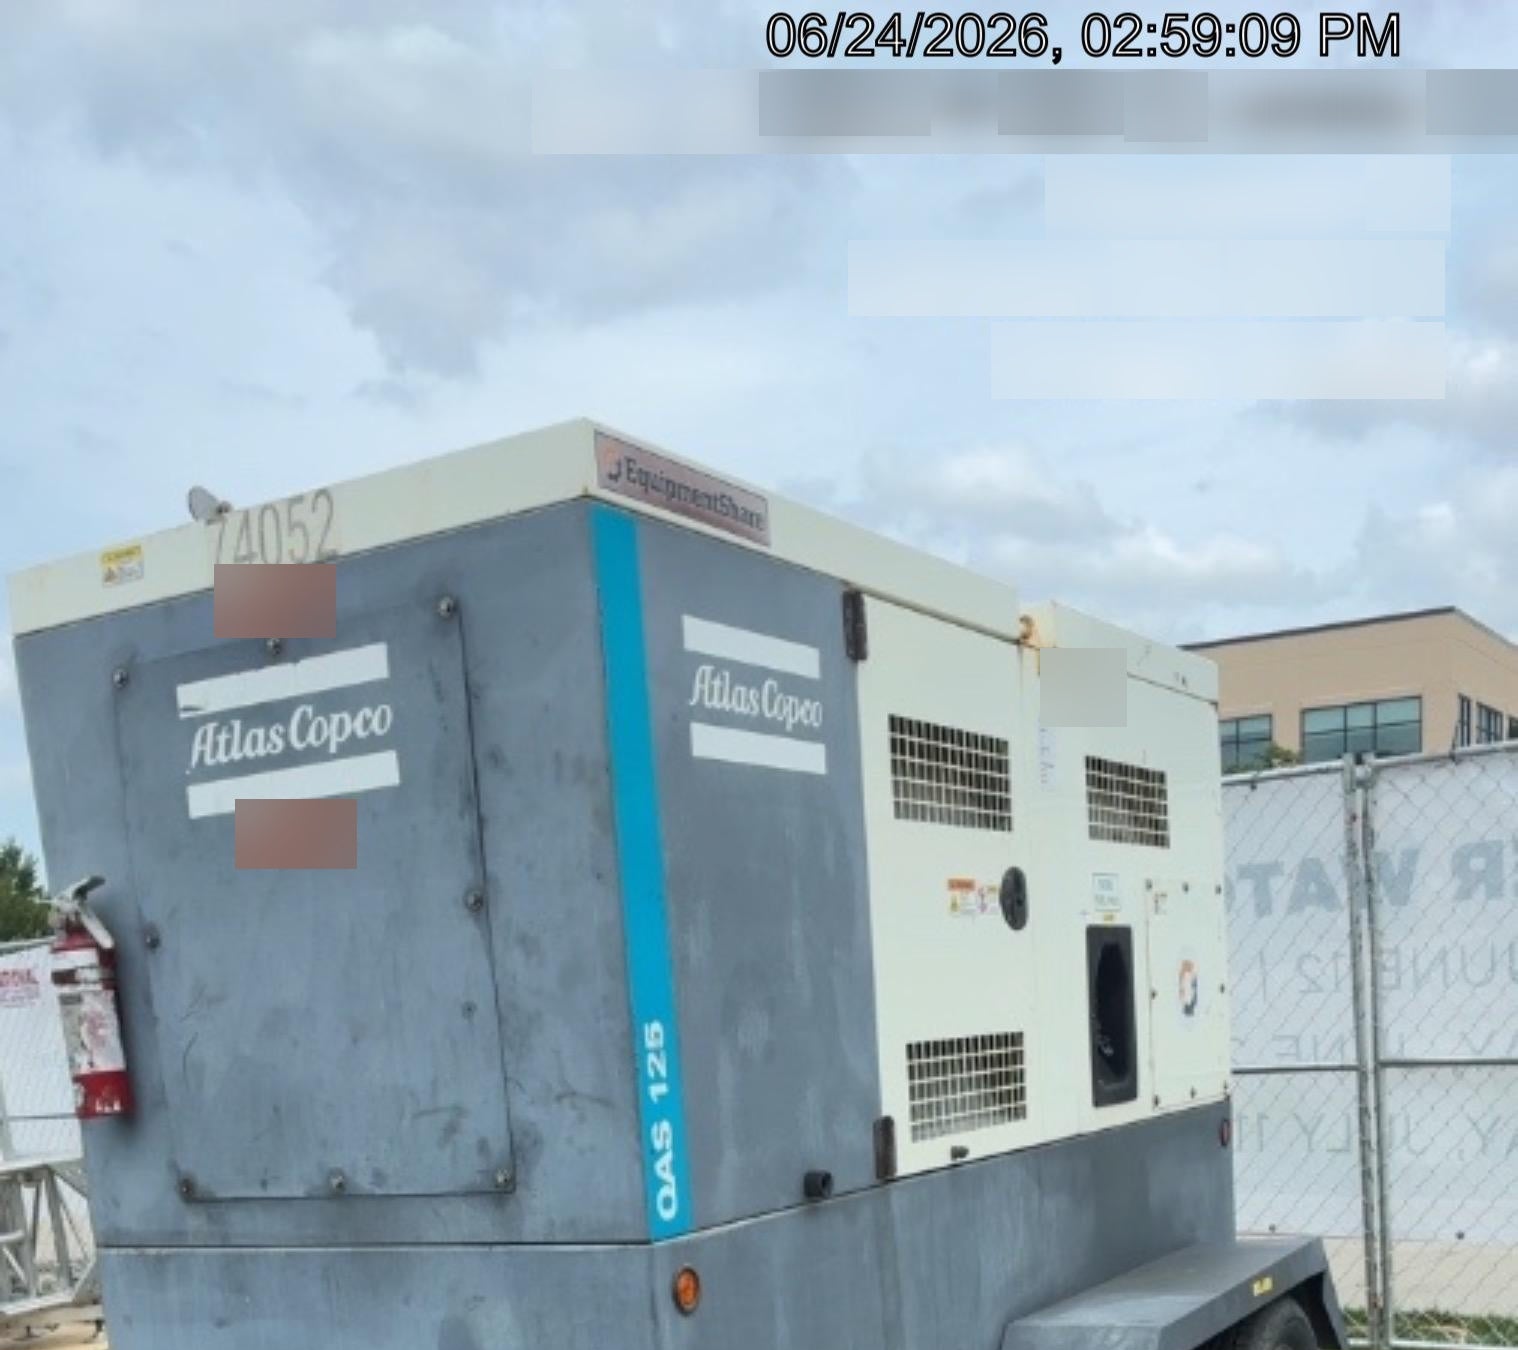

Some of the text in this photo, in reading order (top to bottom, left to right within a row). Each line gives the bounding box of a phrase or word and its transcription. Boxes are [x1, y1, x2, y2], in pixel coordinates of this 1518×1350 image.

[625, 457, 764, 530] EquipmentShare
[689, 664, 823, 731] Atlas Copco
[190, 704, 391, 769] Atlas Copco
[644, 1020, 678, 1221] QAS 125
